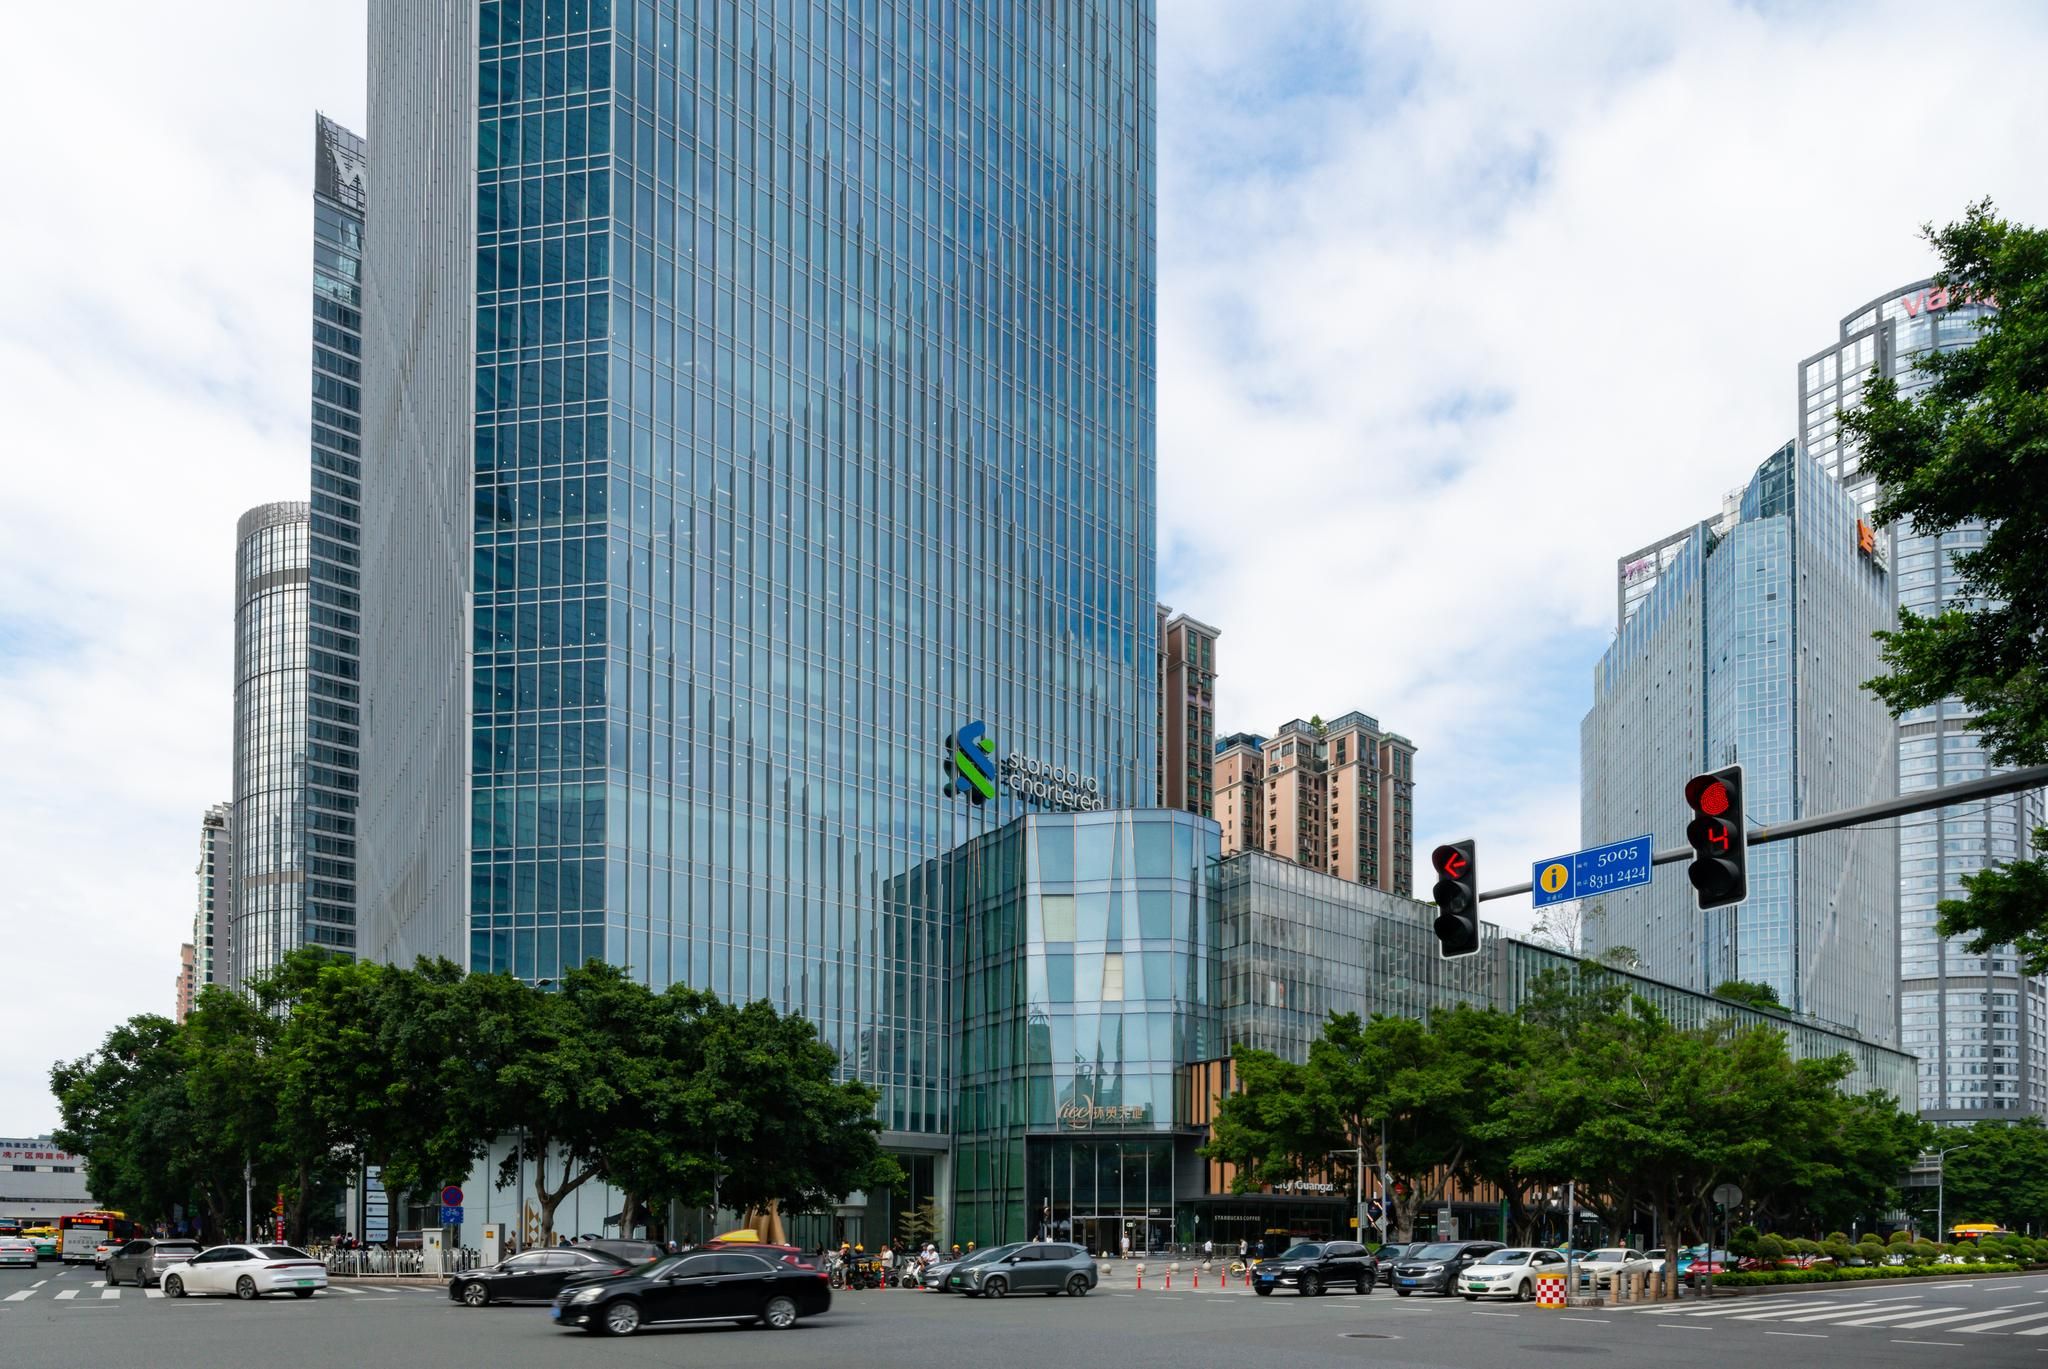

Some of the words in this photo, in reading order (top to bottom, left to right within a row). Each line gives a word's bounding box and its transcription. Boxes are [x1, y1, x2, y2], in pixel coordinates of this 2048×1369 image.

[1008, 751, 1098, 793] standard
[1009, 770, 1104, 811] chartered
[1708, 824, 1729, 849] 4
[1597, 846, 1638, 868] 5005
[1589, 873, 1613, 888] 8311
[1617, 866, 1646, 882] 2424
